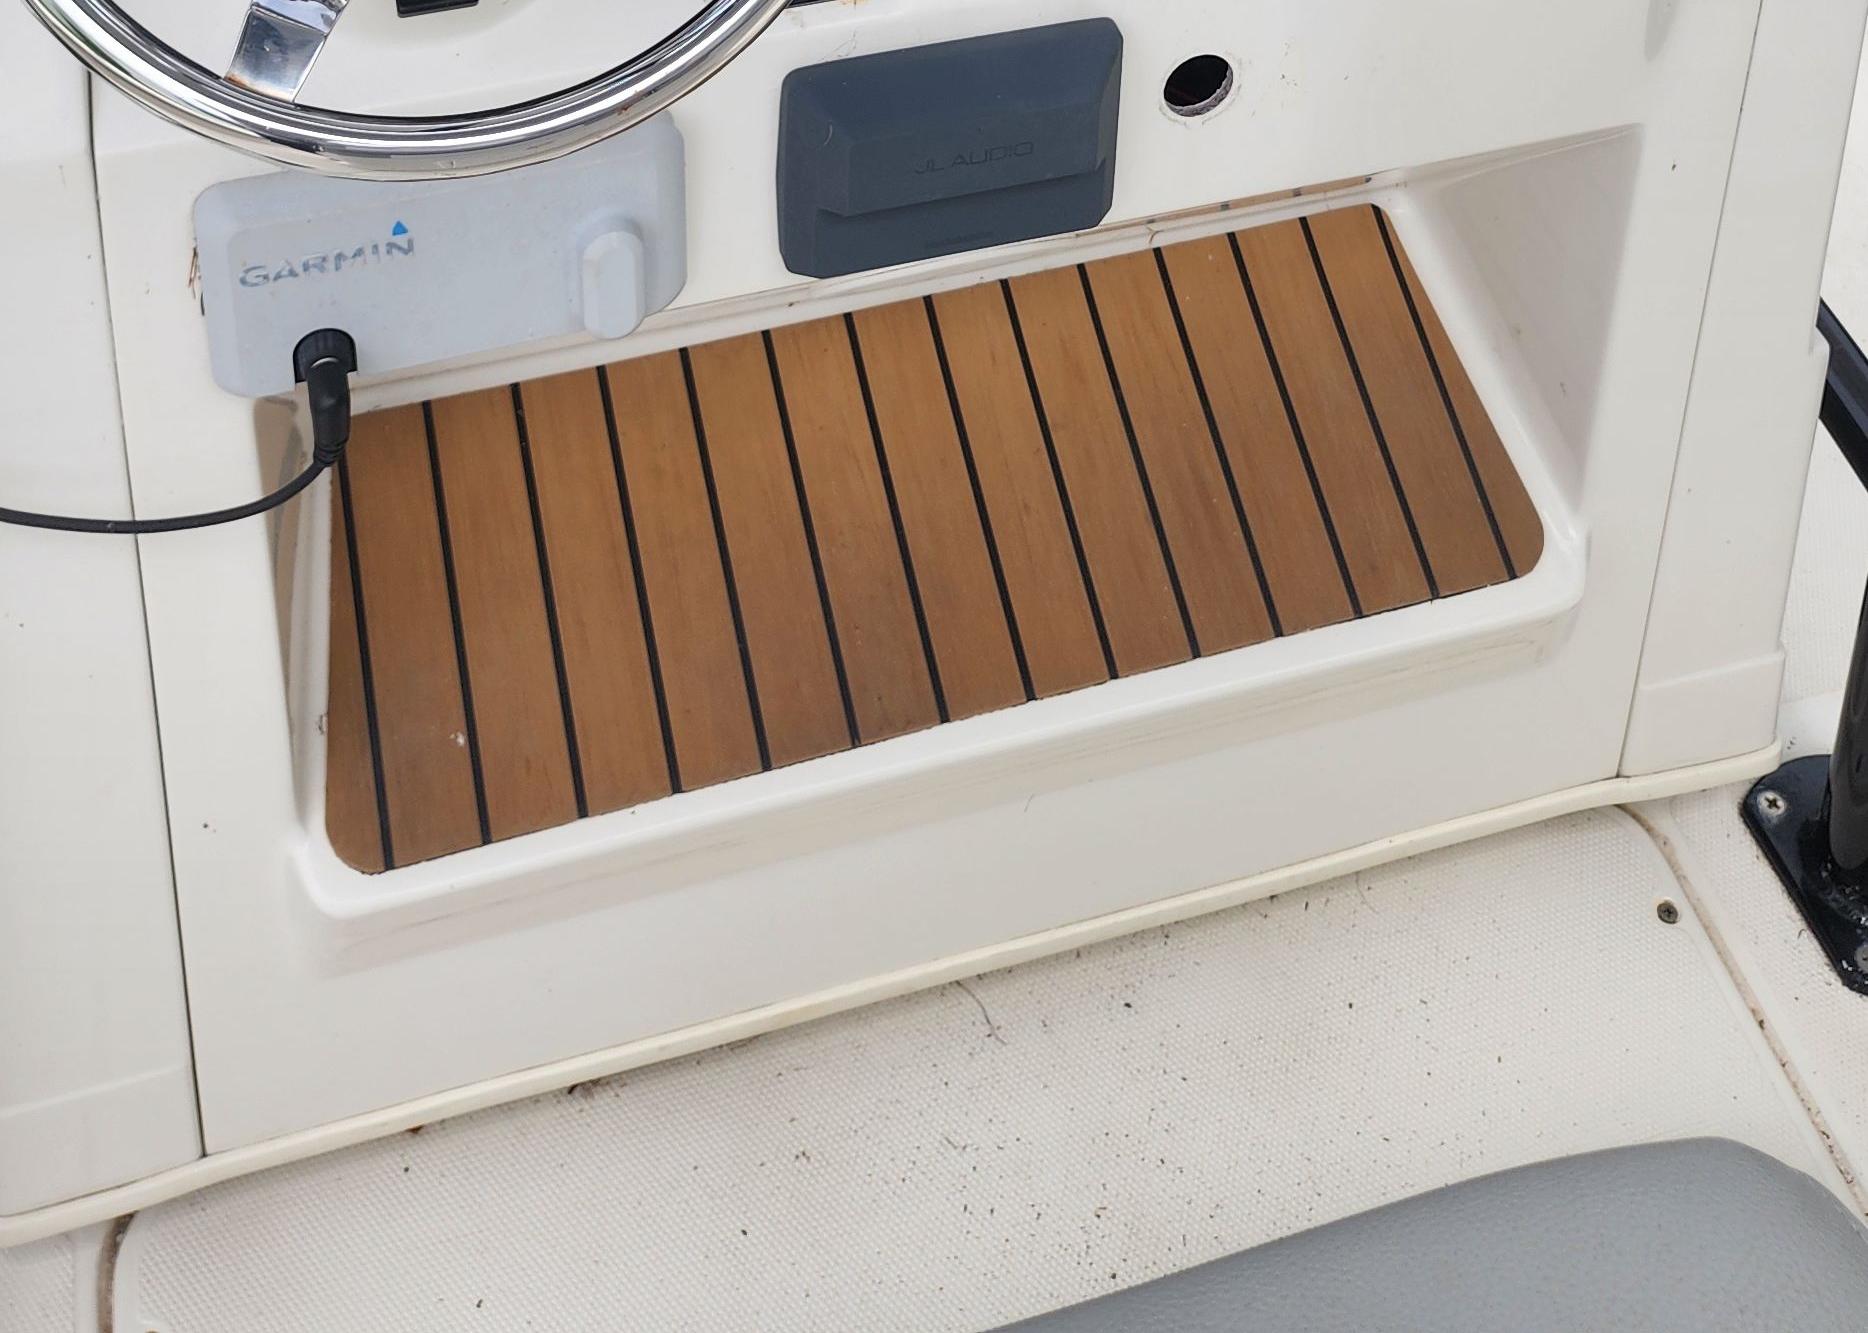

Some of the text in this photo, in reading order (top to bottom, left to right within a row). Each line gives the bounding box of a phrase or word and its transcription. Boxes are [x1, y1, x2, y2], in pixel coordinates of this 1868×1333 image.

[913, 140, 1035, 175] JL AUDIO
[238, 235, 416, 288] GARMIN
